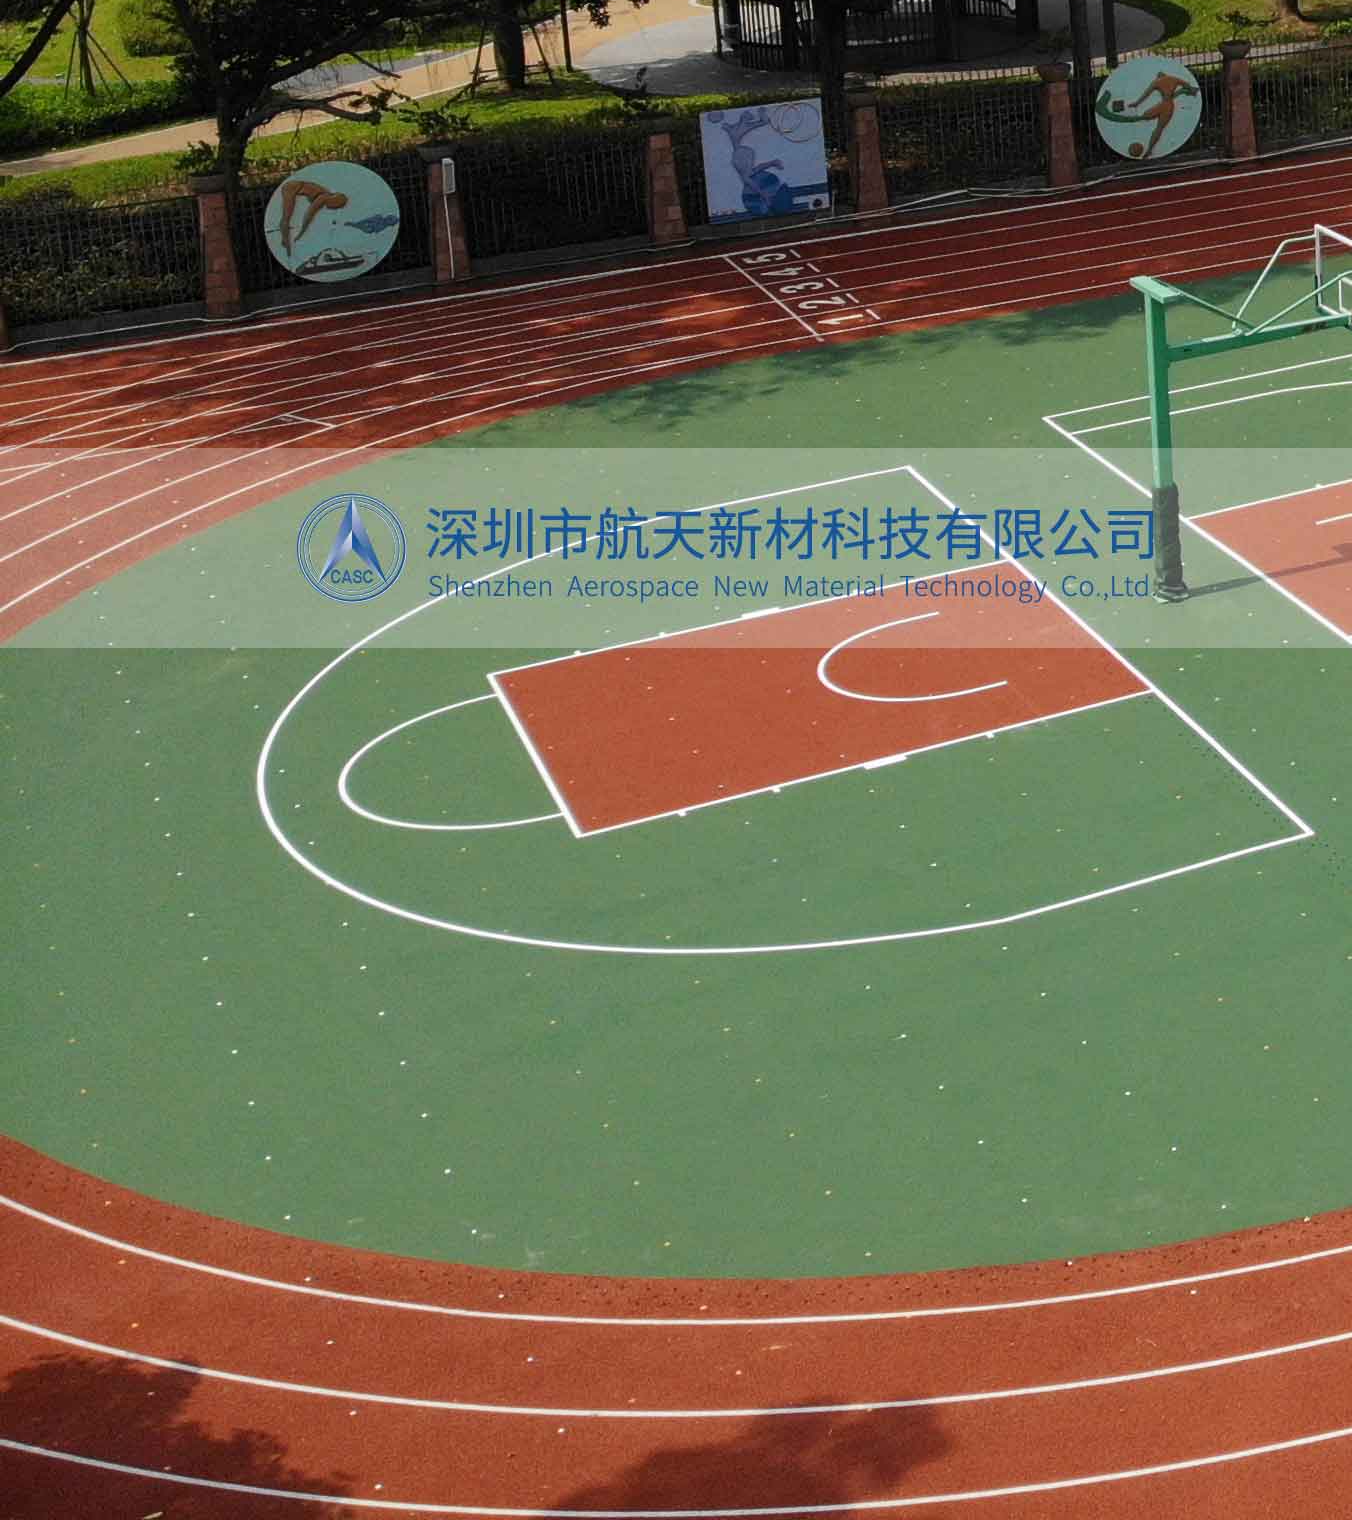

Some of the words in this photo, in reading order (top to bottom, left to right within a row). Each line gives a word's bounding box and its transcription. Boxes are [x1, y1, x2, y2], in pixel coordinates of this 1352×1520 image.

[779, 281, 825, 294] 3
[798, 296, 847, 310] 2
[817, 313, 864, 325] 1
